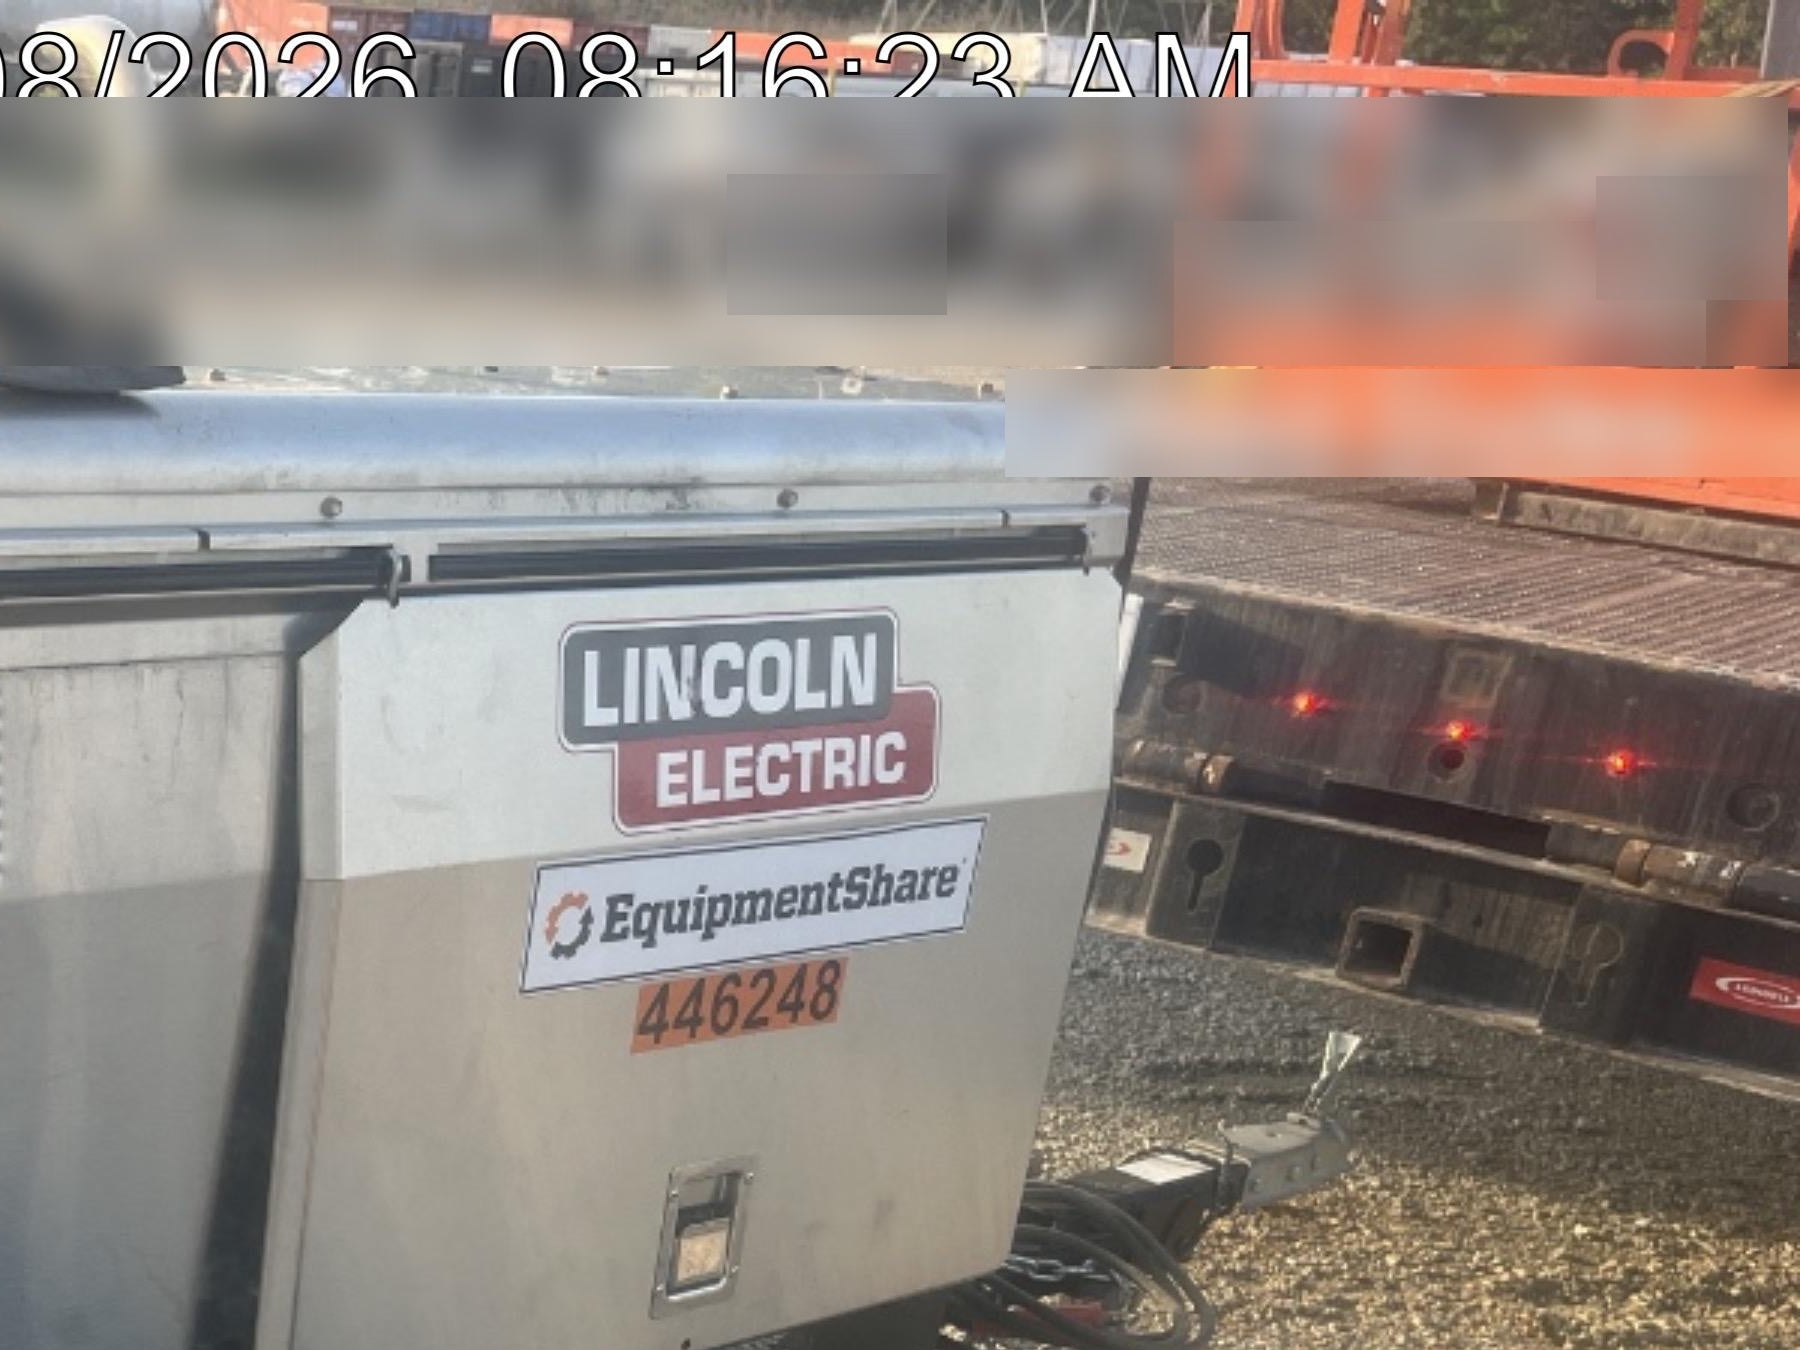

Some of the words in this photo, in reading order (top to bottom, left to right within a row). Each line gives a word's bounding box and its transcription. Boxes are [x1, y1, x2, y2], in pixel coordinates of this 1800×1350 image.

[583, 632, 877, 727] LINCOLN
[656, 731, 907, 808] ELECTRIC
[600, 862, 960, 950] EquipmentShare
[637, 959, 842, 1046] 446248
